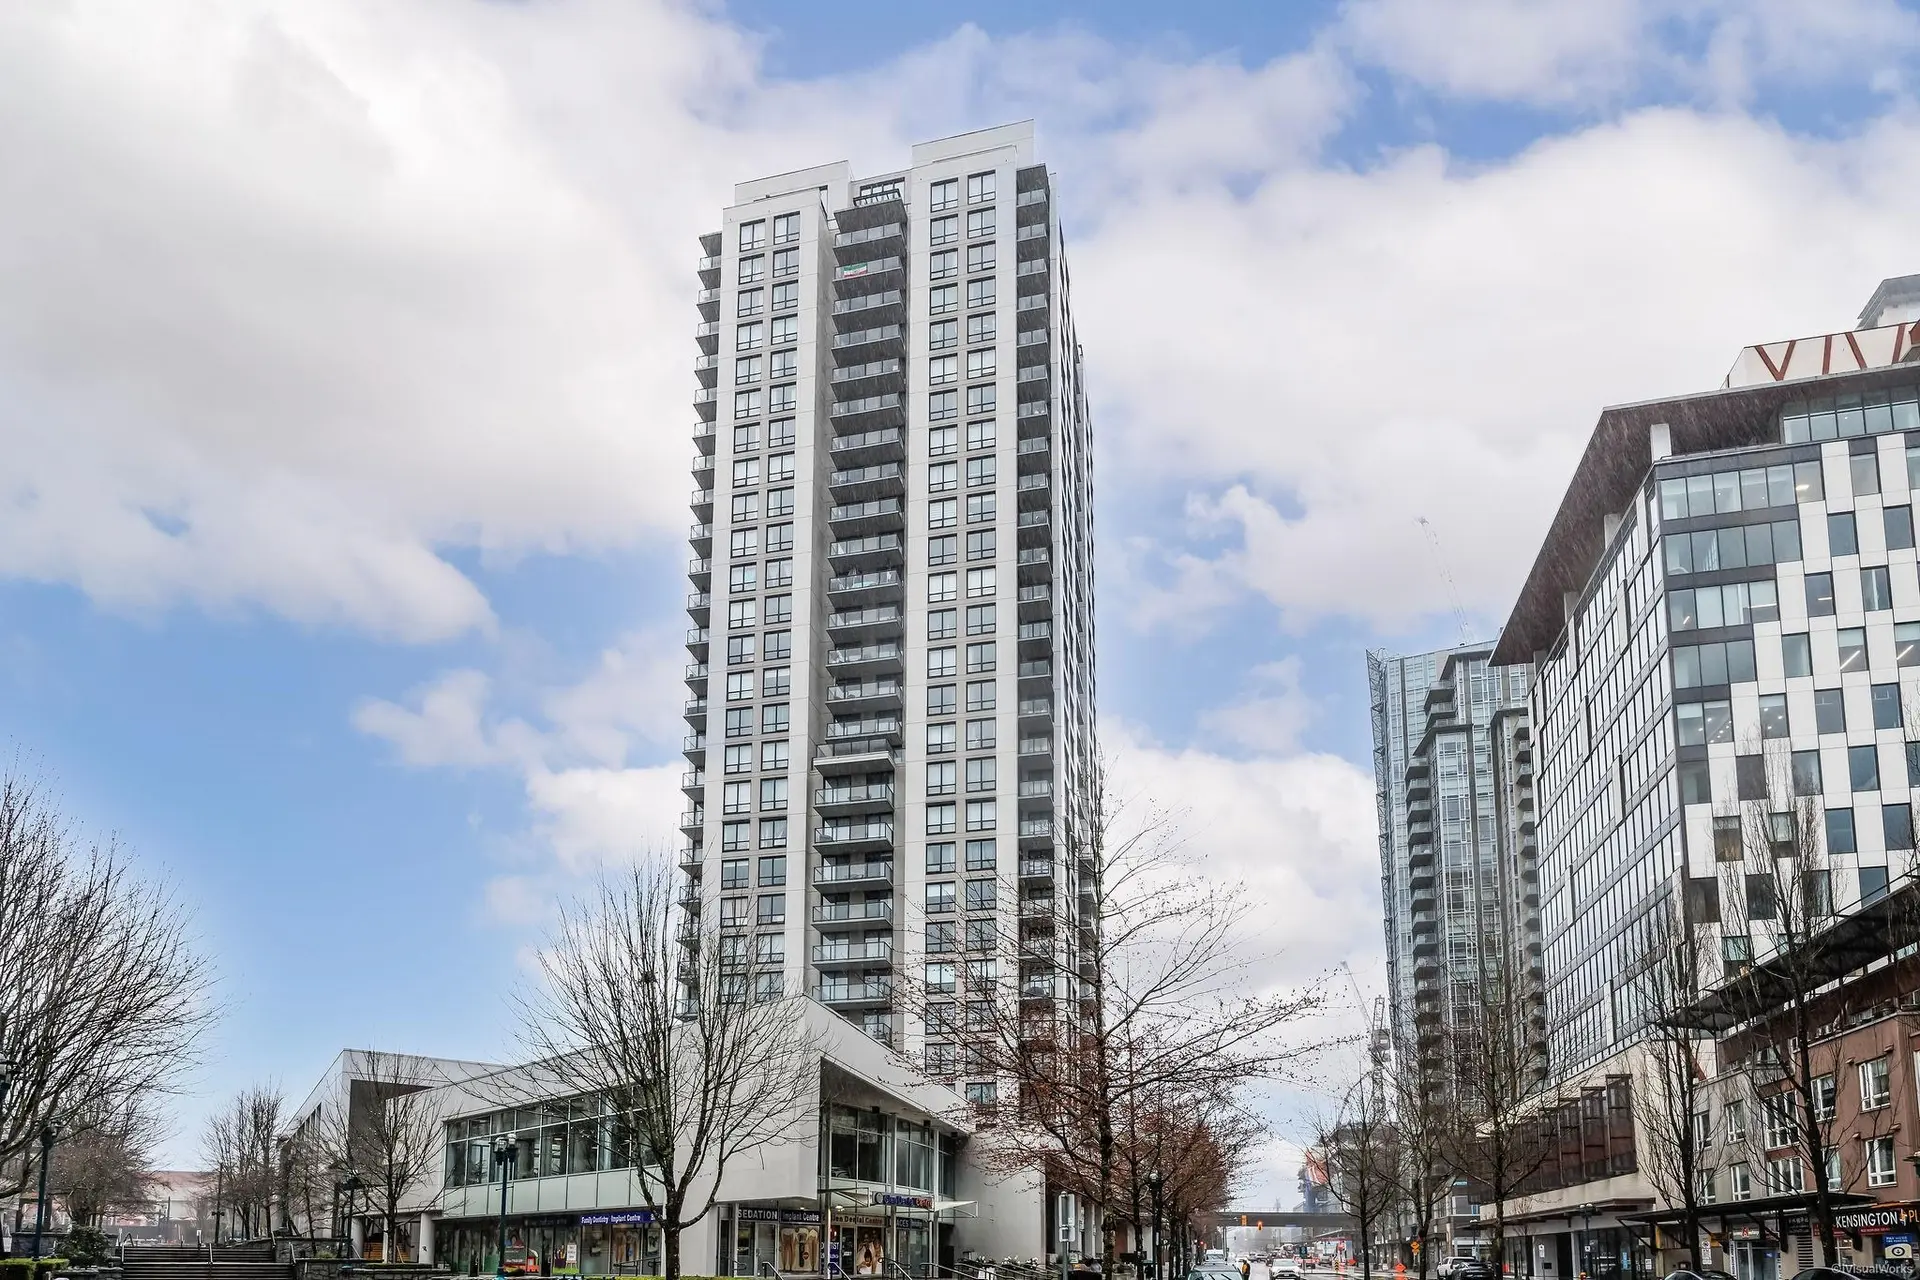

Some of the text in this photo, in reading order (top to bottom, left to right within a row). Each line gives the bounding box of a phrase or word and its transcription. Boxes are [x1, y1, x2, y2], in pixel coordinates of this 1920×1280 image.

[626, 1213, 641, 1222] Centre
[738, 1209, 778, 1220] SEDATION
[803, 1212, 820, 1222] Centre
[1835, 1211, 1898, 1228] KENSINGTON
